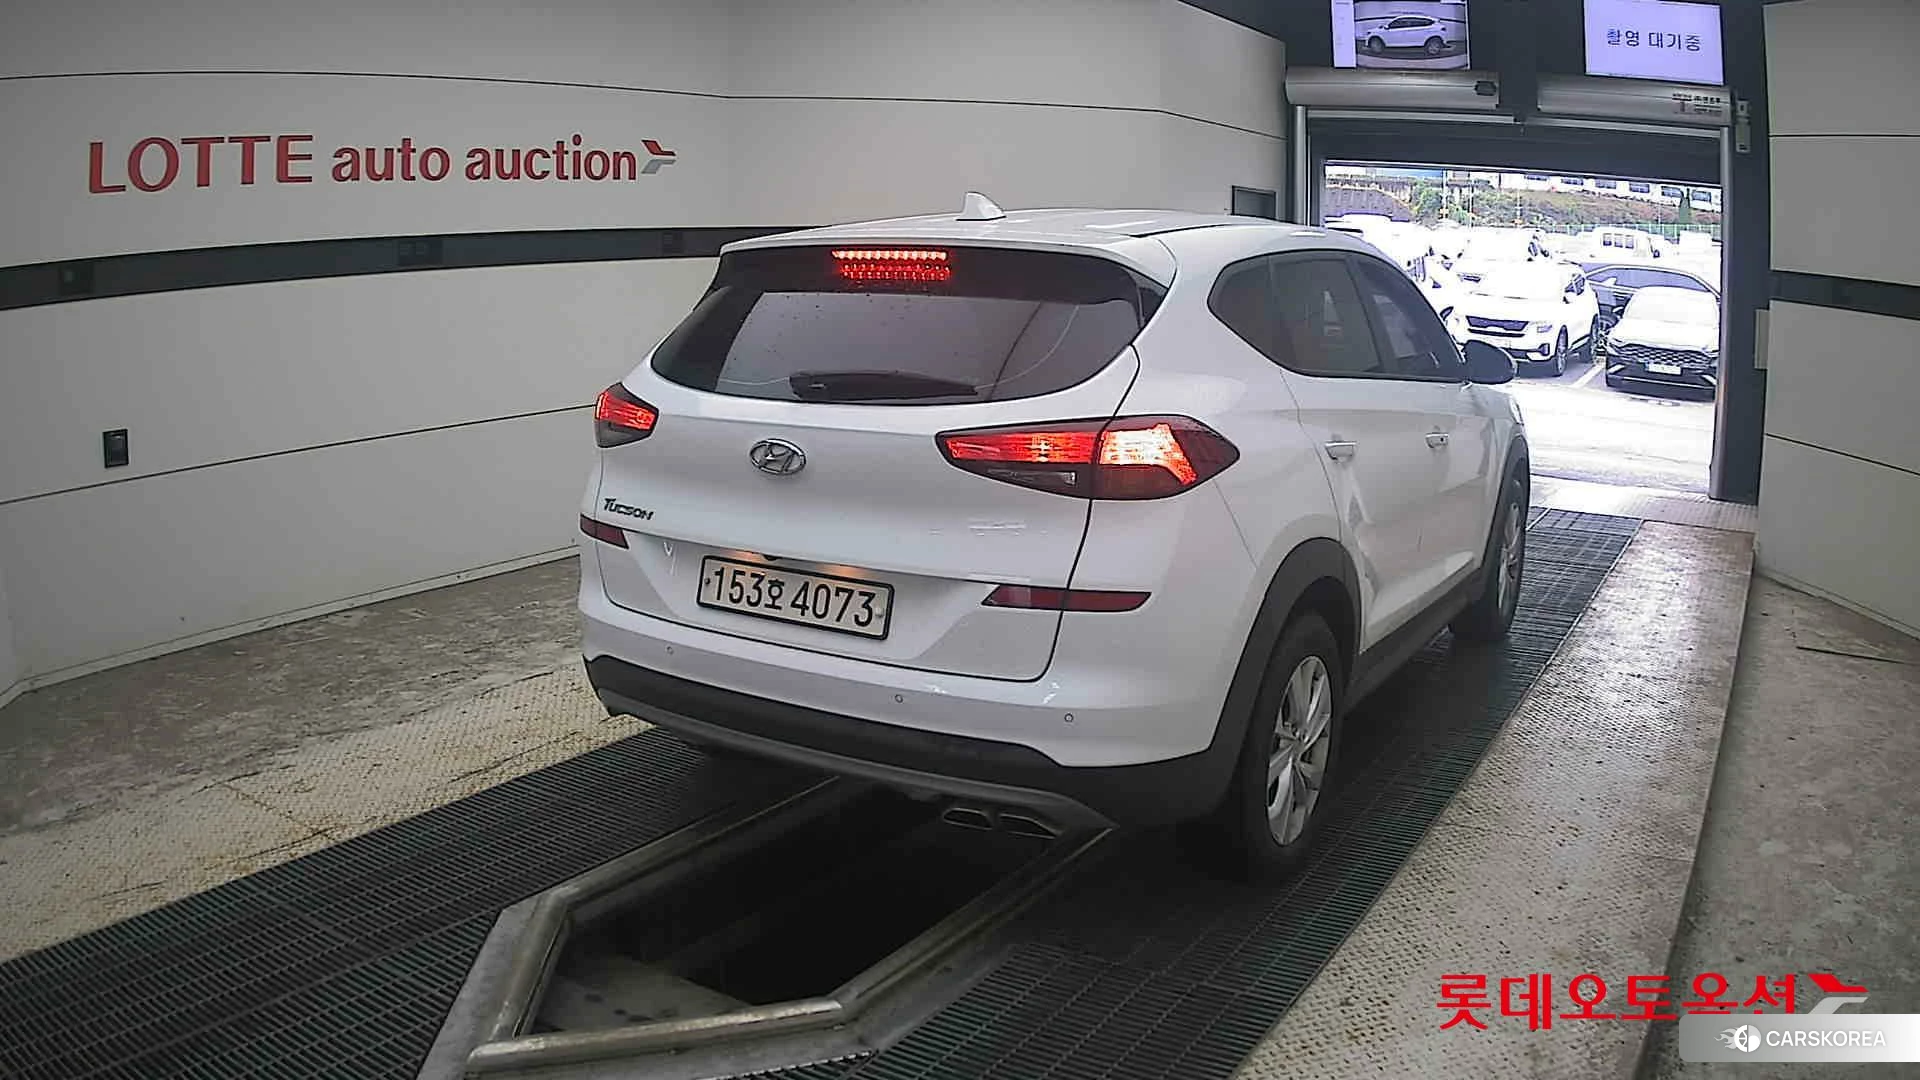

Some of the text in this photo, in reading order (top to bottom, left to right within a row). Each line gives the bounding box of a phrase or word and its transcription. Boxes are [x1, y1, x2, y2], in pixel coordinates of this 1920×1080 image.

[1648, 32, 1701, 52] 대기중
[88, 134, 638, 194] LOTTE auto auction
[714, 566, 876, 627] 153호 4073
